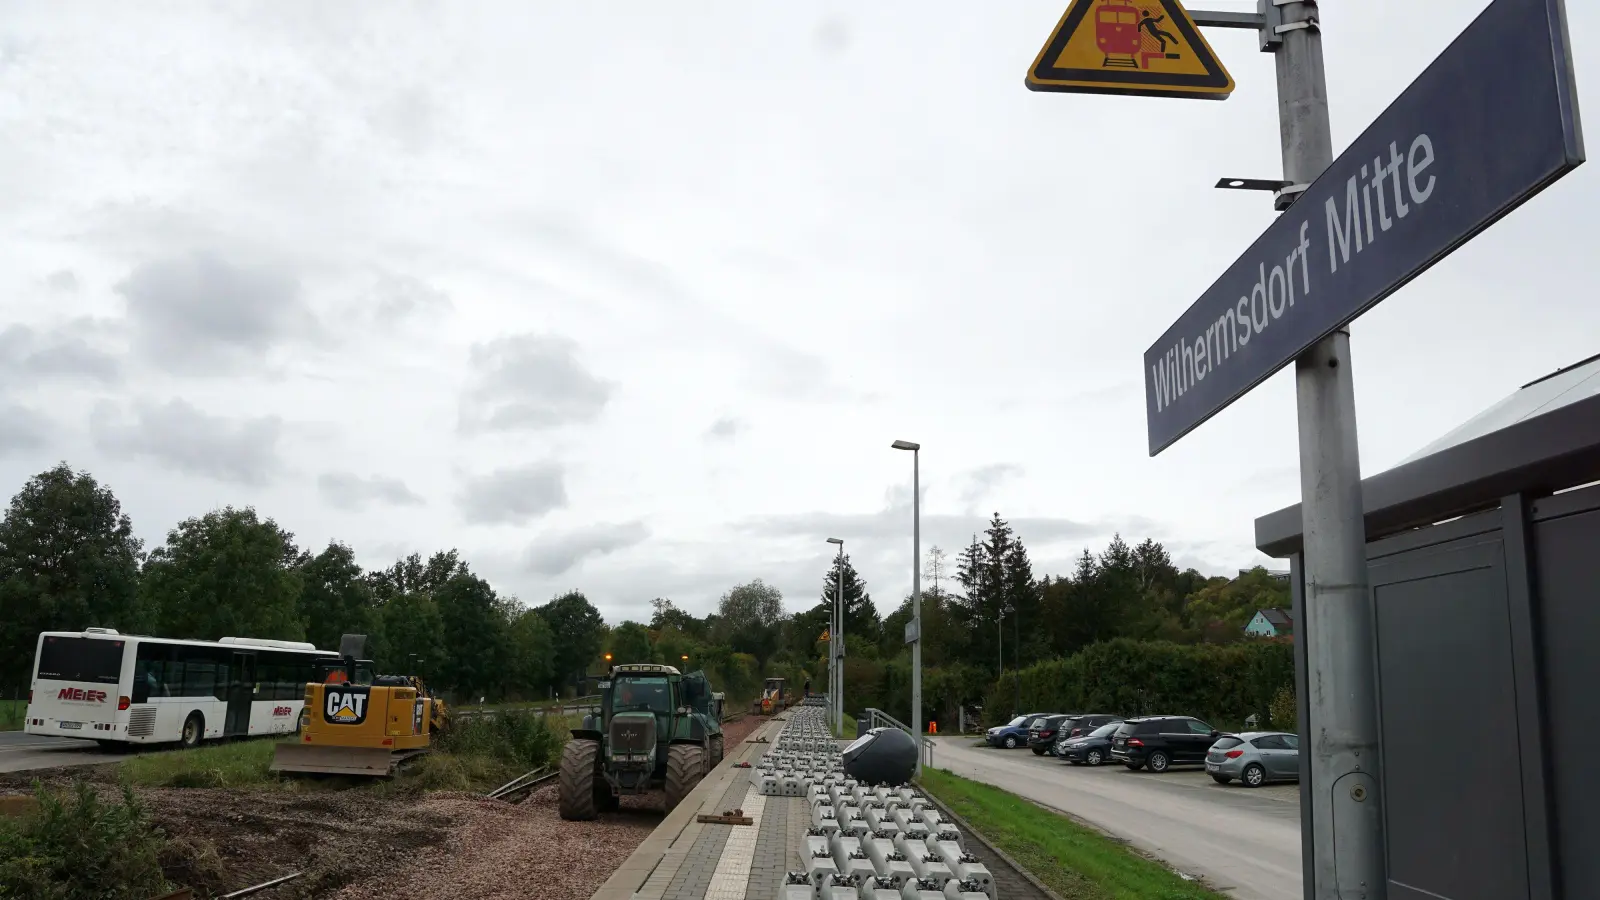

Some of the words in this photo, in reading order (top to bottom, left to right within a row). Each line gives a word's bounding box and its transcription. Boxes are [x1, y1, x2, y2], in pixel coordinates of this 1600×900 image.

[1152, 221, 1310, 413] Wilhermsdorf
[1325, 133, 1437, 274] Mitte
[57, 687, 107, 703] MEIER
[327, 692, 367, 718] CAT
[272, 706, 292, 716] MEIER
